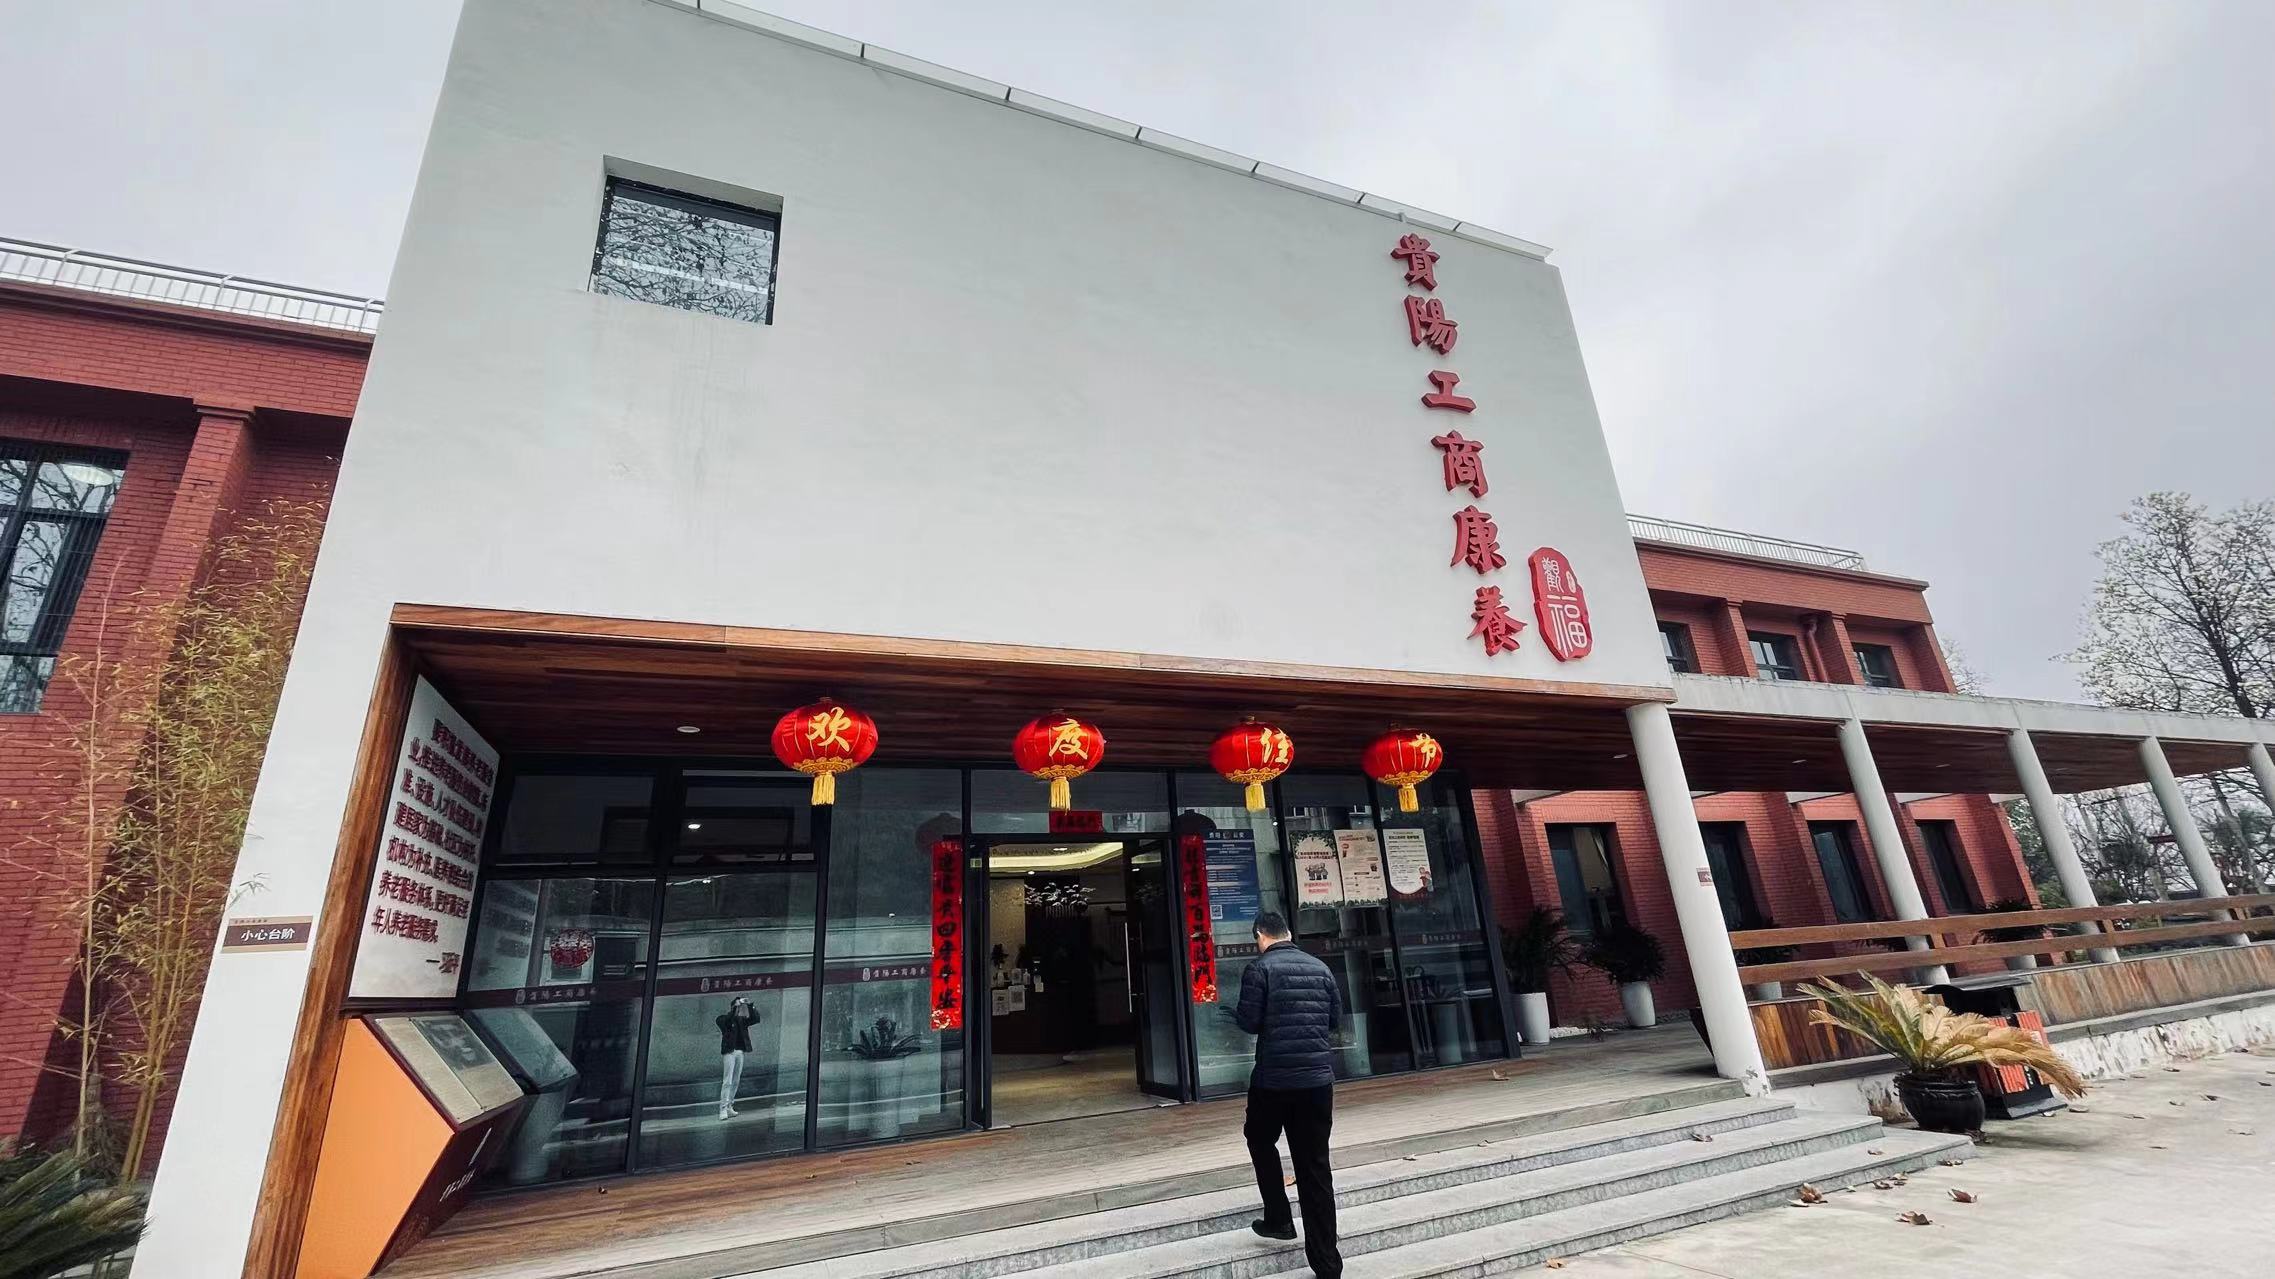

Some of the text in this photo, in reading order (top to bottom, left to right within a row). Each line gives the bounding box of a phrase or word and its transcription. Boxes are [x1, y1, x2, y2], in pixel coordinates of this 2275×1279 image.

[805, 707, 1438, 769] 欢 度 佳 节
[240, 927, 296, 942] 小心台阶
